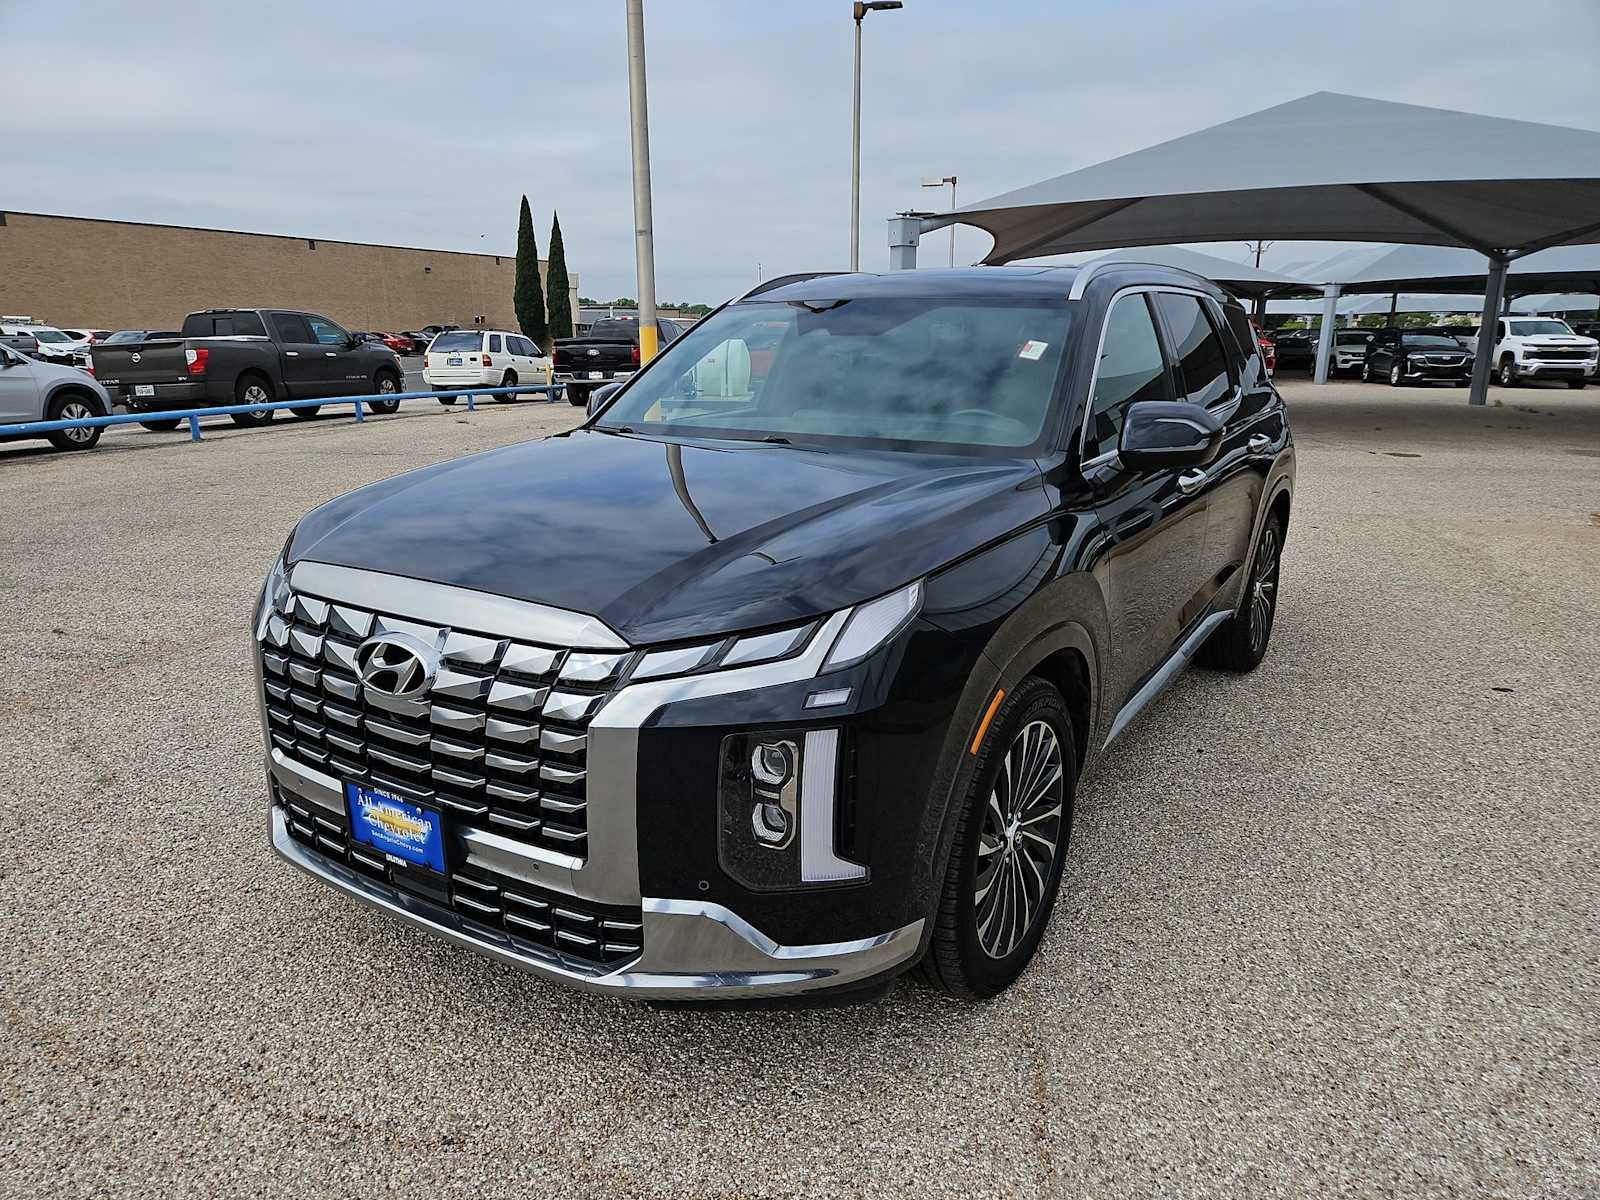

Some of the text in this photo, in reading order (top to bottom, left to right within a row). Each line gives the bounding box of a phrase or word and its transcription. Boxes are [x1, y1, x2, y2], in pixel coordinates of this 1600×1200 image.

[357, 793, 433, 831] All American
[368, 812, 426, 844] Chevrolet
